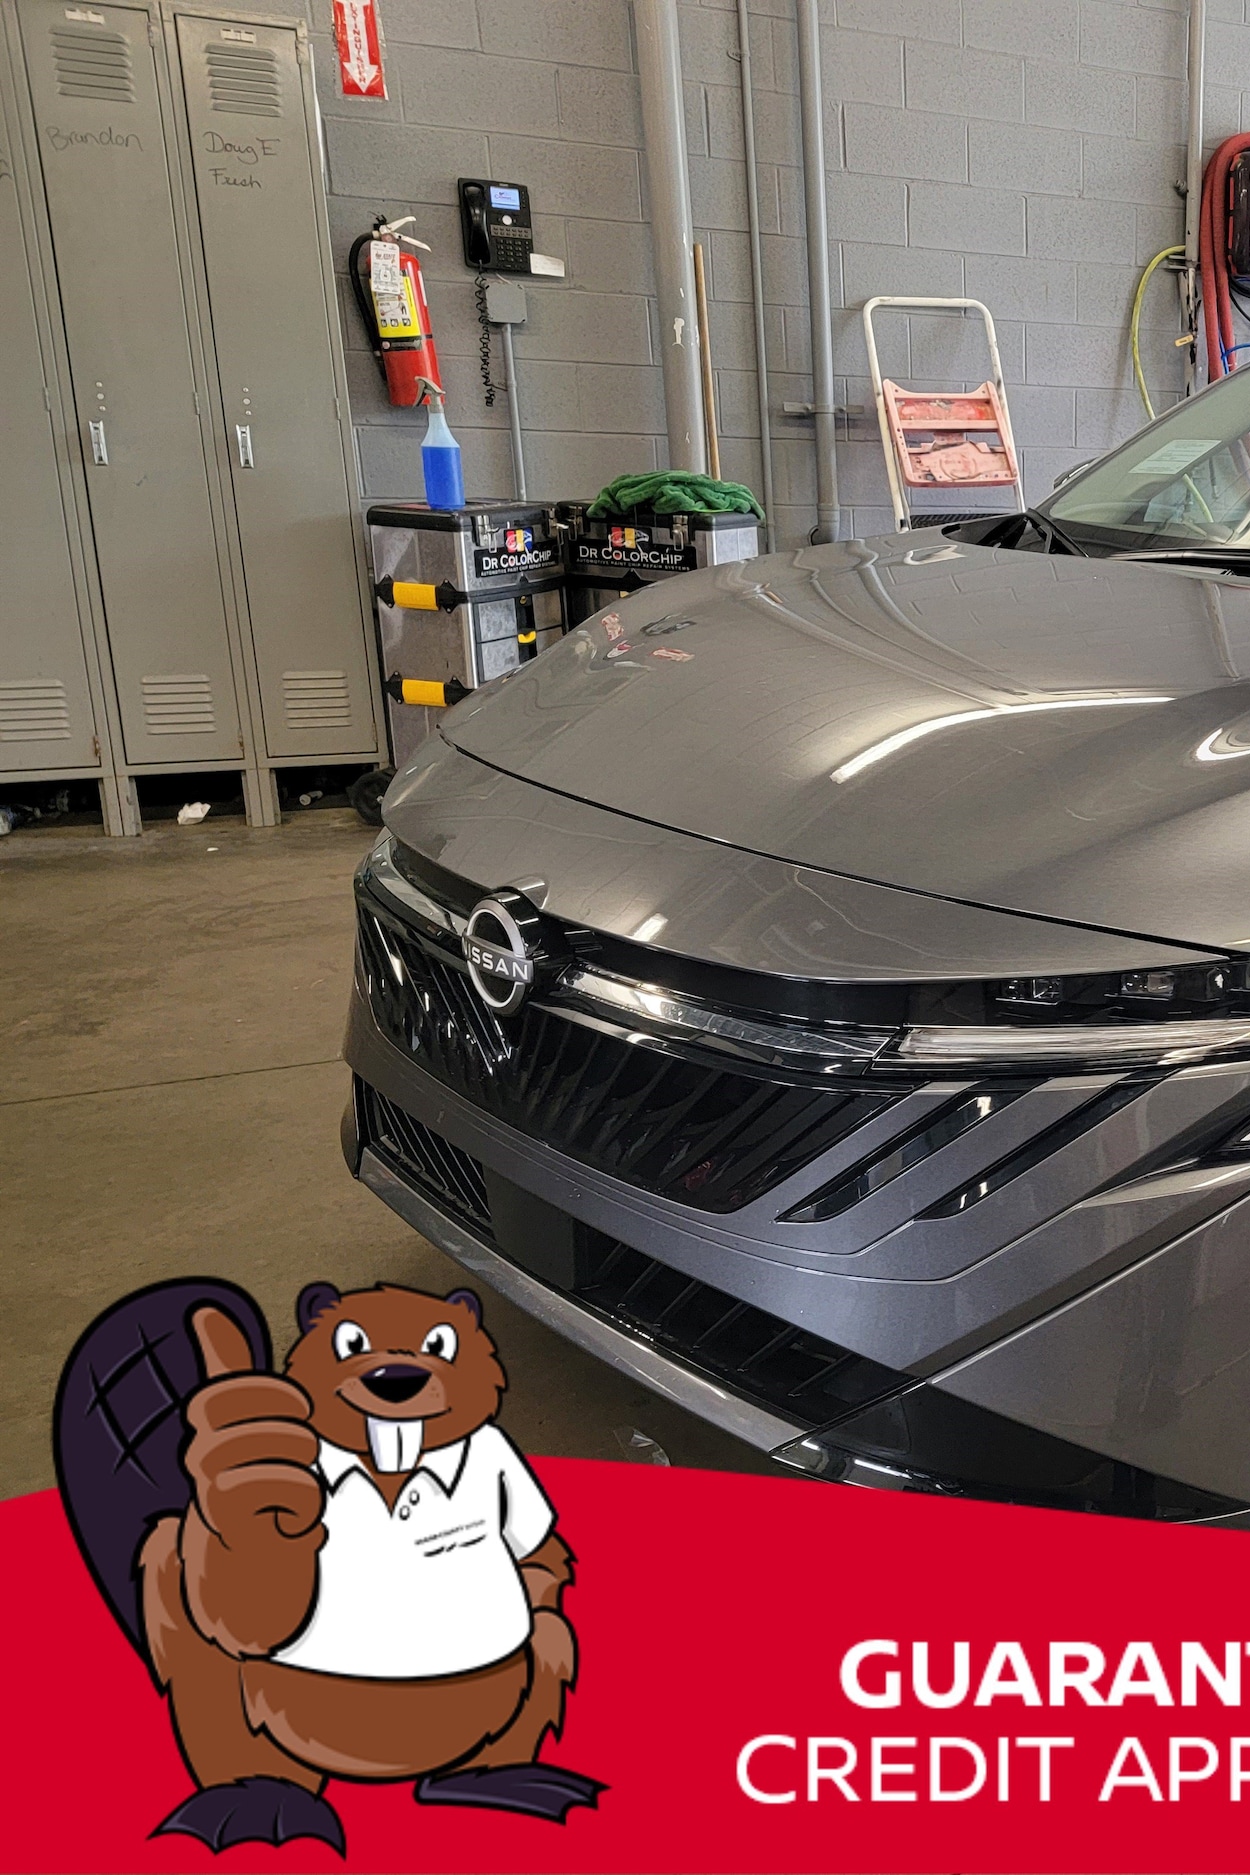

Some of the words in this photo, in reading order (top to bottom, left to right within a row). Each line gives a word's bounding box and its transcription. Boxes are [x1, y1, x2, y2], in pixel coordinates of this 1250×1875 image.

[45, 126, 144, 152] Brandon
[203, 131, 259, 165] Doug
[255, 137, 281, 155] E
[461, 936, 529, 980] NISSAN
